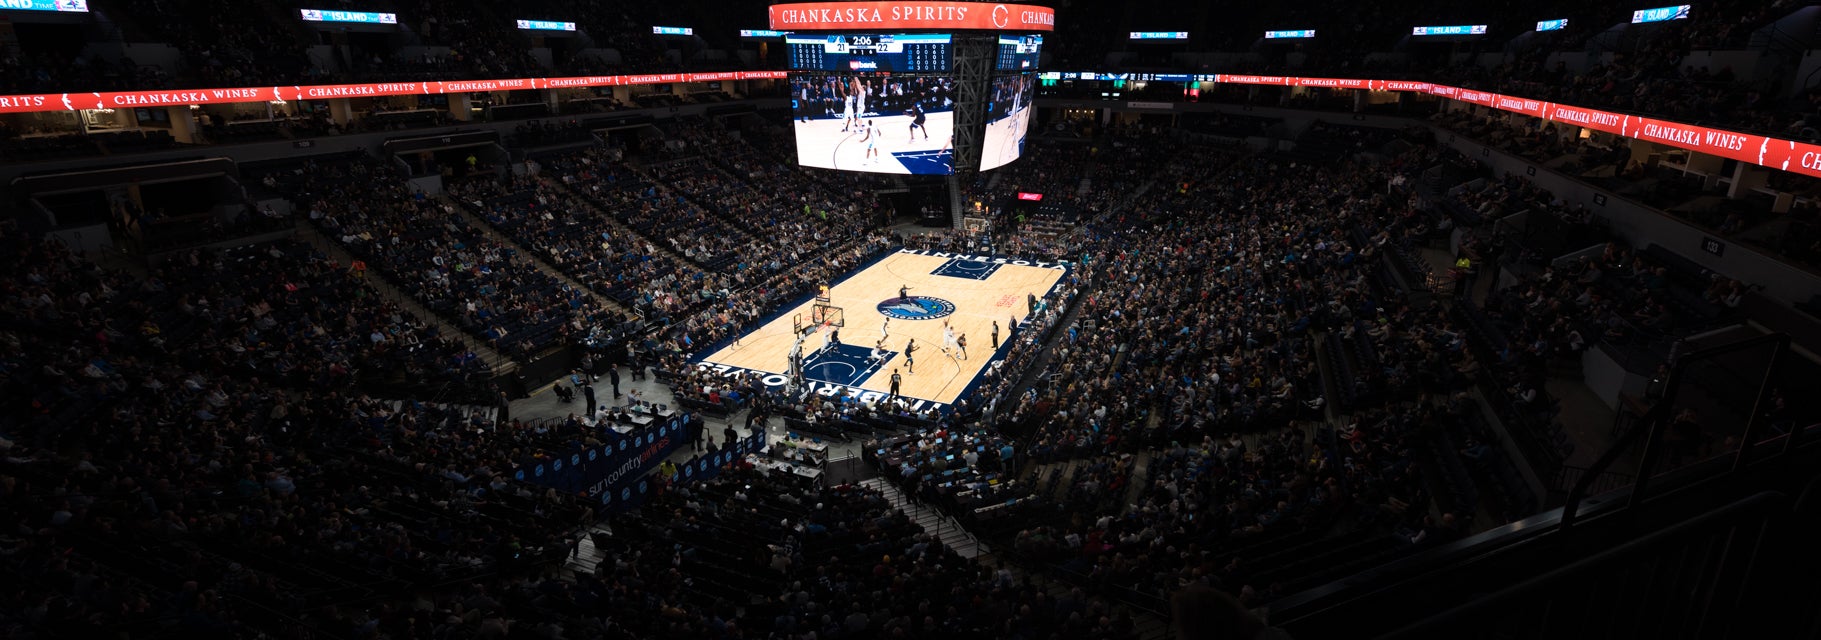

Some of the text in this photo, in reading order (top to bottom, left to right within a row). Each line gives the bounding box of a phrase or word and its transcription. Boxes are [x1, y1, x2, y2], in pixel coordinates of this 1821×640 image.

[331, 11, 367, 21] ISLAND
[782, 6, 966, 24] CHANKASKA SPIRITS
[1433, 26, 1461, 34] ISLAND
[853, 36, 872, 45] 2:06
[837, 43, 845, 52] 21
[877, 43, 888, 52] 22
[309, 83, 415, 97] CHANKASKA SPIRITS
[448, 82, 497, 91] CHANKASKA
[114, 89, 257, 105] CHANKASKA WINES
[1500, 98, 1539, 111] CHANKASKA WINES
[1555, 108, 1619, 127] CHANKASKA SPIRITS
[1644, 123, 1745, 151] CHANKASKA WINES
